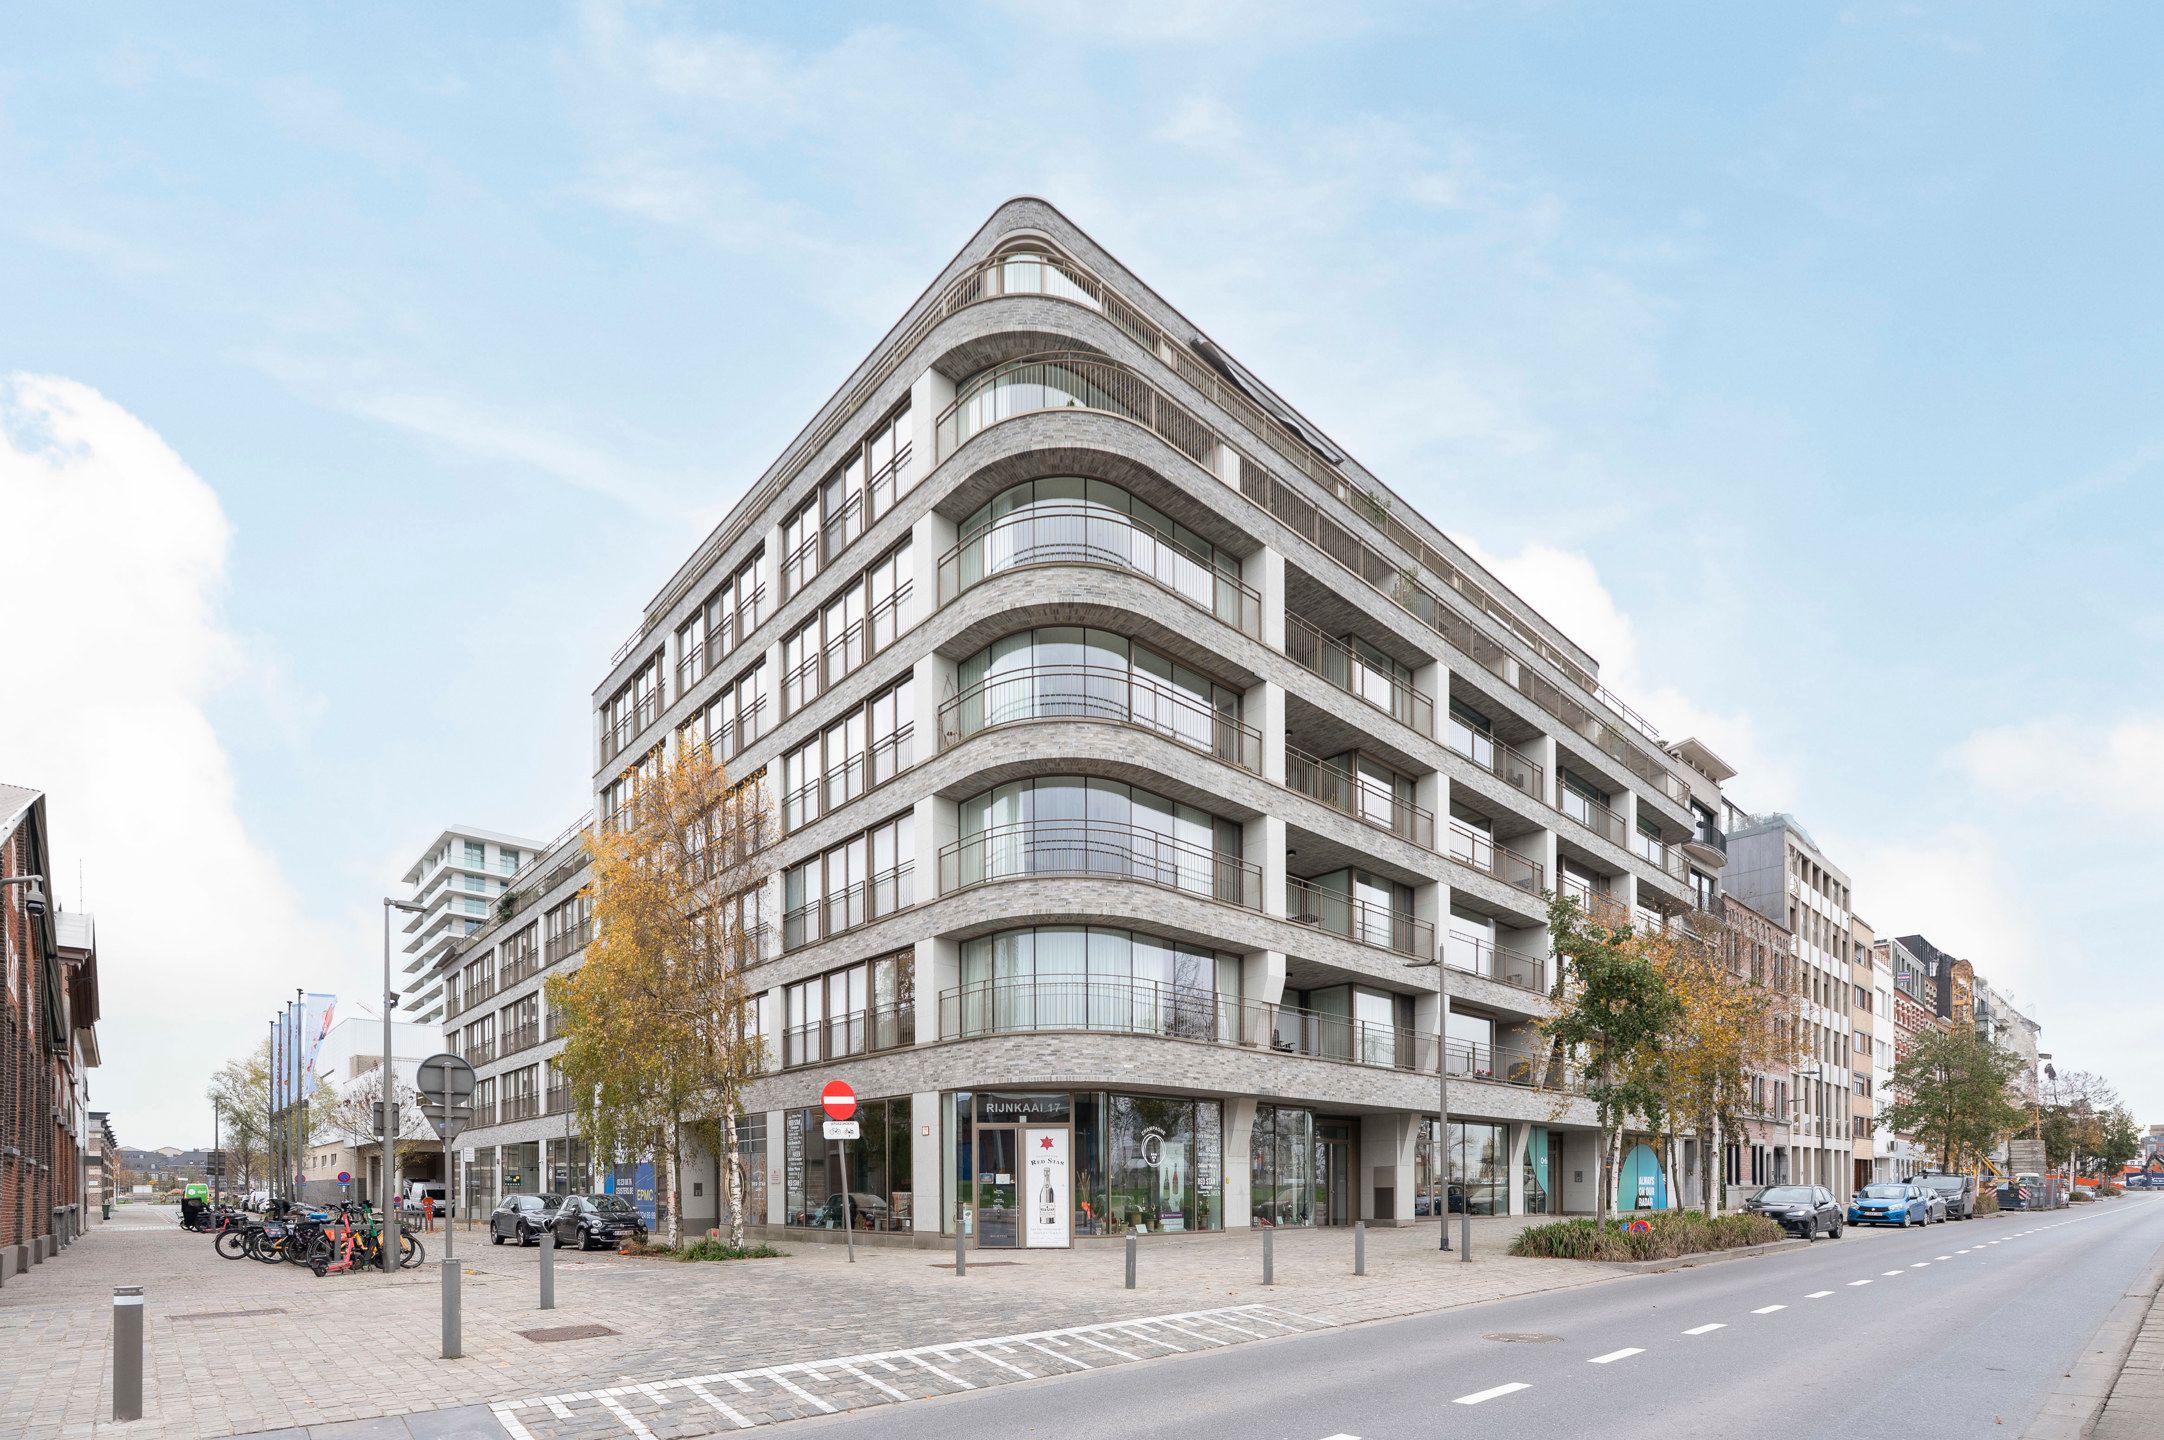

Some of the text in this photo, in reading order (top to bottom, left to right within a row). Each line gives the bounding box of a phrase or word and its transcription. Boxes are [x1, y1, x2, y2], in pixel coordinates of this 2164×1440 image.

[986, 1103, 1061, 1113] RIJNKAAI 17
[1141, 1126, 1167, 1136] CHAMPAGNE
[1638, 1176, 1655, 1186] ALWAYS
[637, 1189, 653, 1201] EPMC
[1646, 1187, 1655, 1196] OUR
[1638, 1197, 1653, 1207] RADAR
